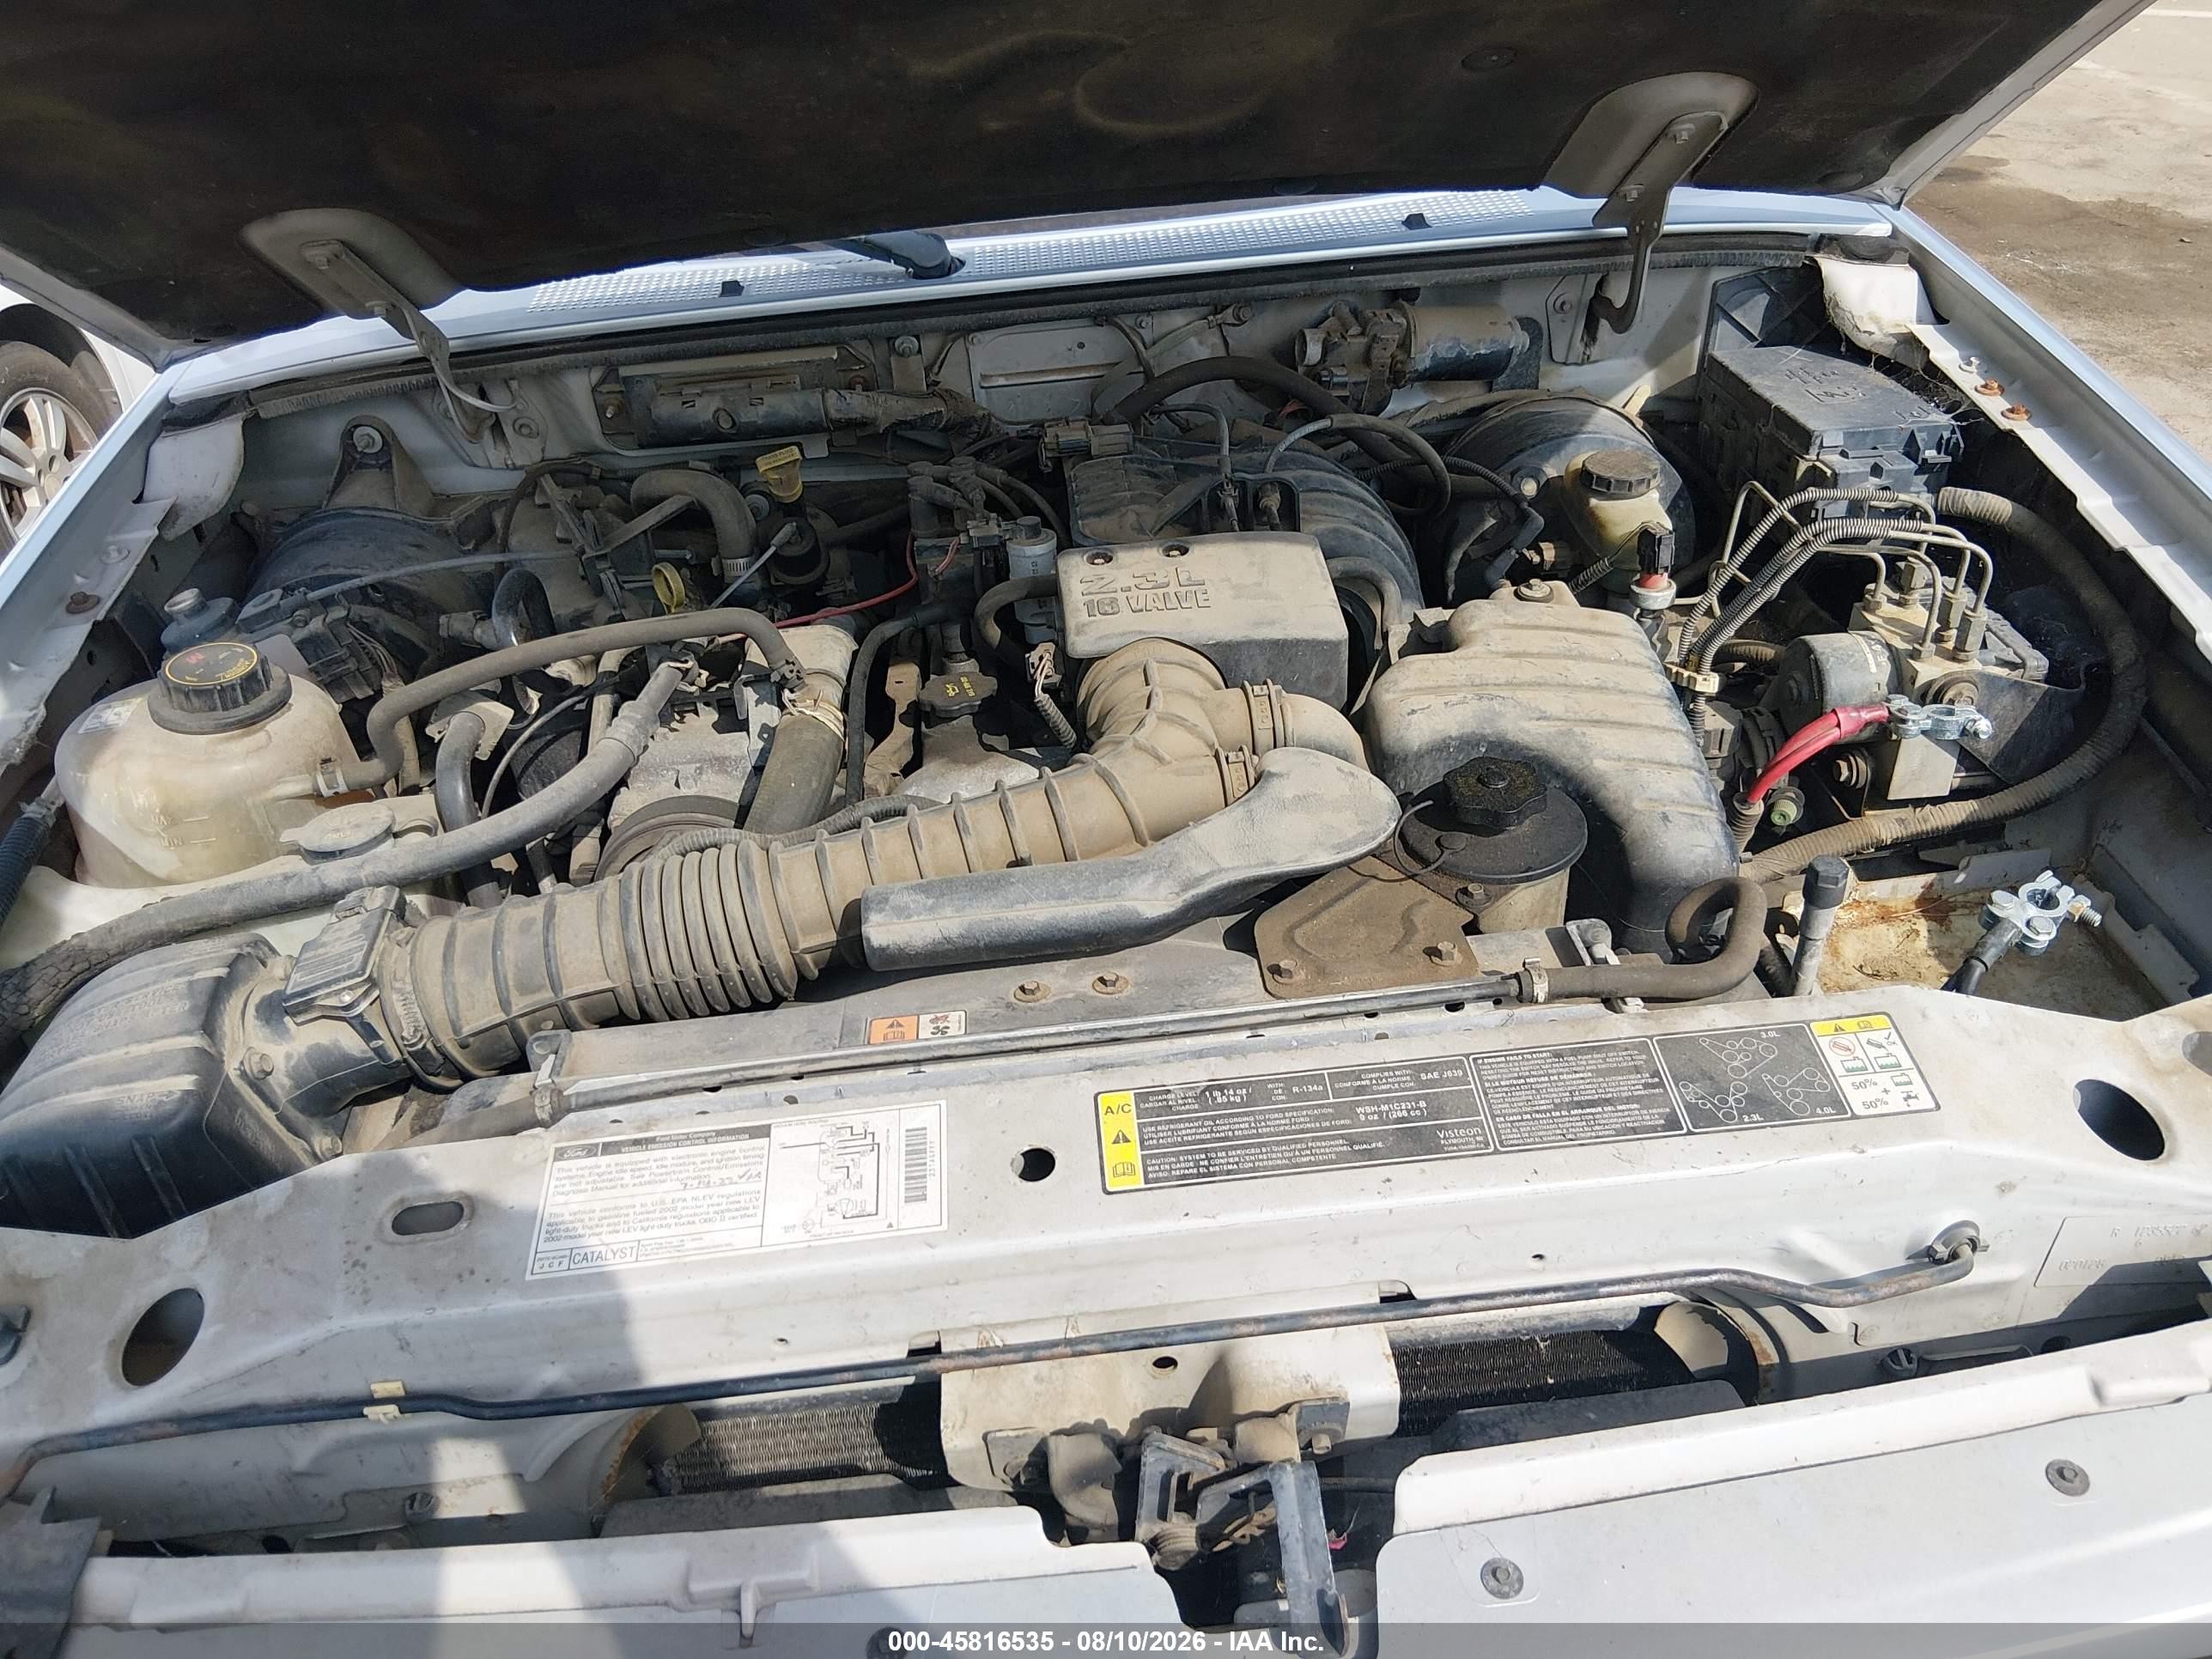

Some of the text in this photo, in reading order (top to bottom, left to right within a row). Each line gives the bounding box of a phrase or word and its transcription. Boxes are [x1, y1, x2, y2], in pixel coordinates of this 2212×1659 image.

[1083, 589, 1211, 617] 16 VALVE
[1759, 1030, 1781, 1038] 3.0L
[1419, 1068, 1463, 1080] SAE J639
[1291, 1083, 1323, 1093] R-134a
[1849, 1078, 1880, 1090] 50%
[1223, 1087, 1235, 1096] 14
[1103, 1102, 1133, 1115] A/C
[1859, 1097, 1890, 1109] 50%
[1814, 1106, 1837, 1115] 4.0L
[1741, 1113, 1765, 1122] 2.3L
[1435, 1125, 1482, 1139] Visteon
[572, 1245, 635, 1265] CATALYST
